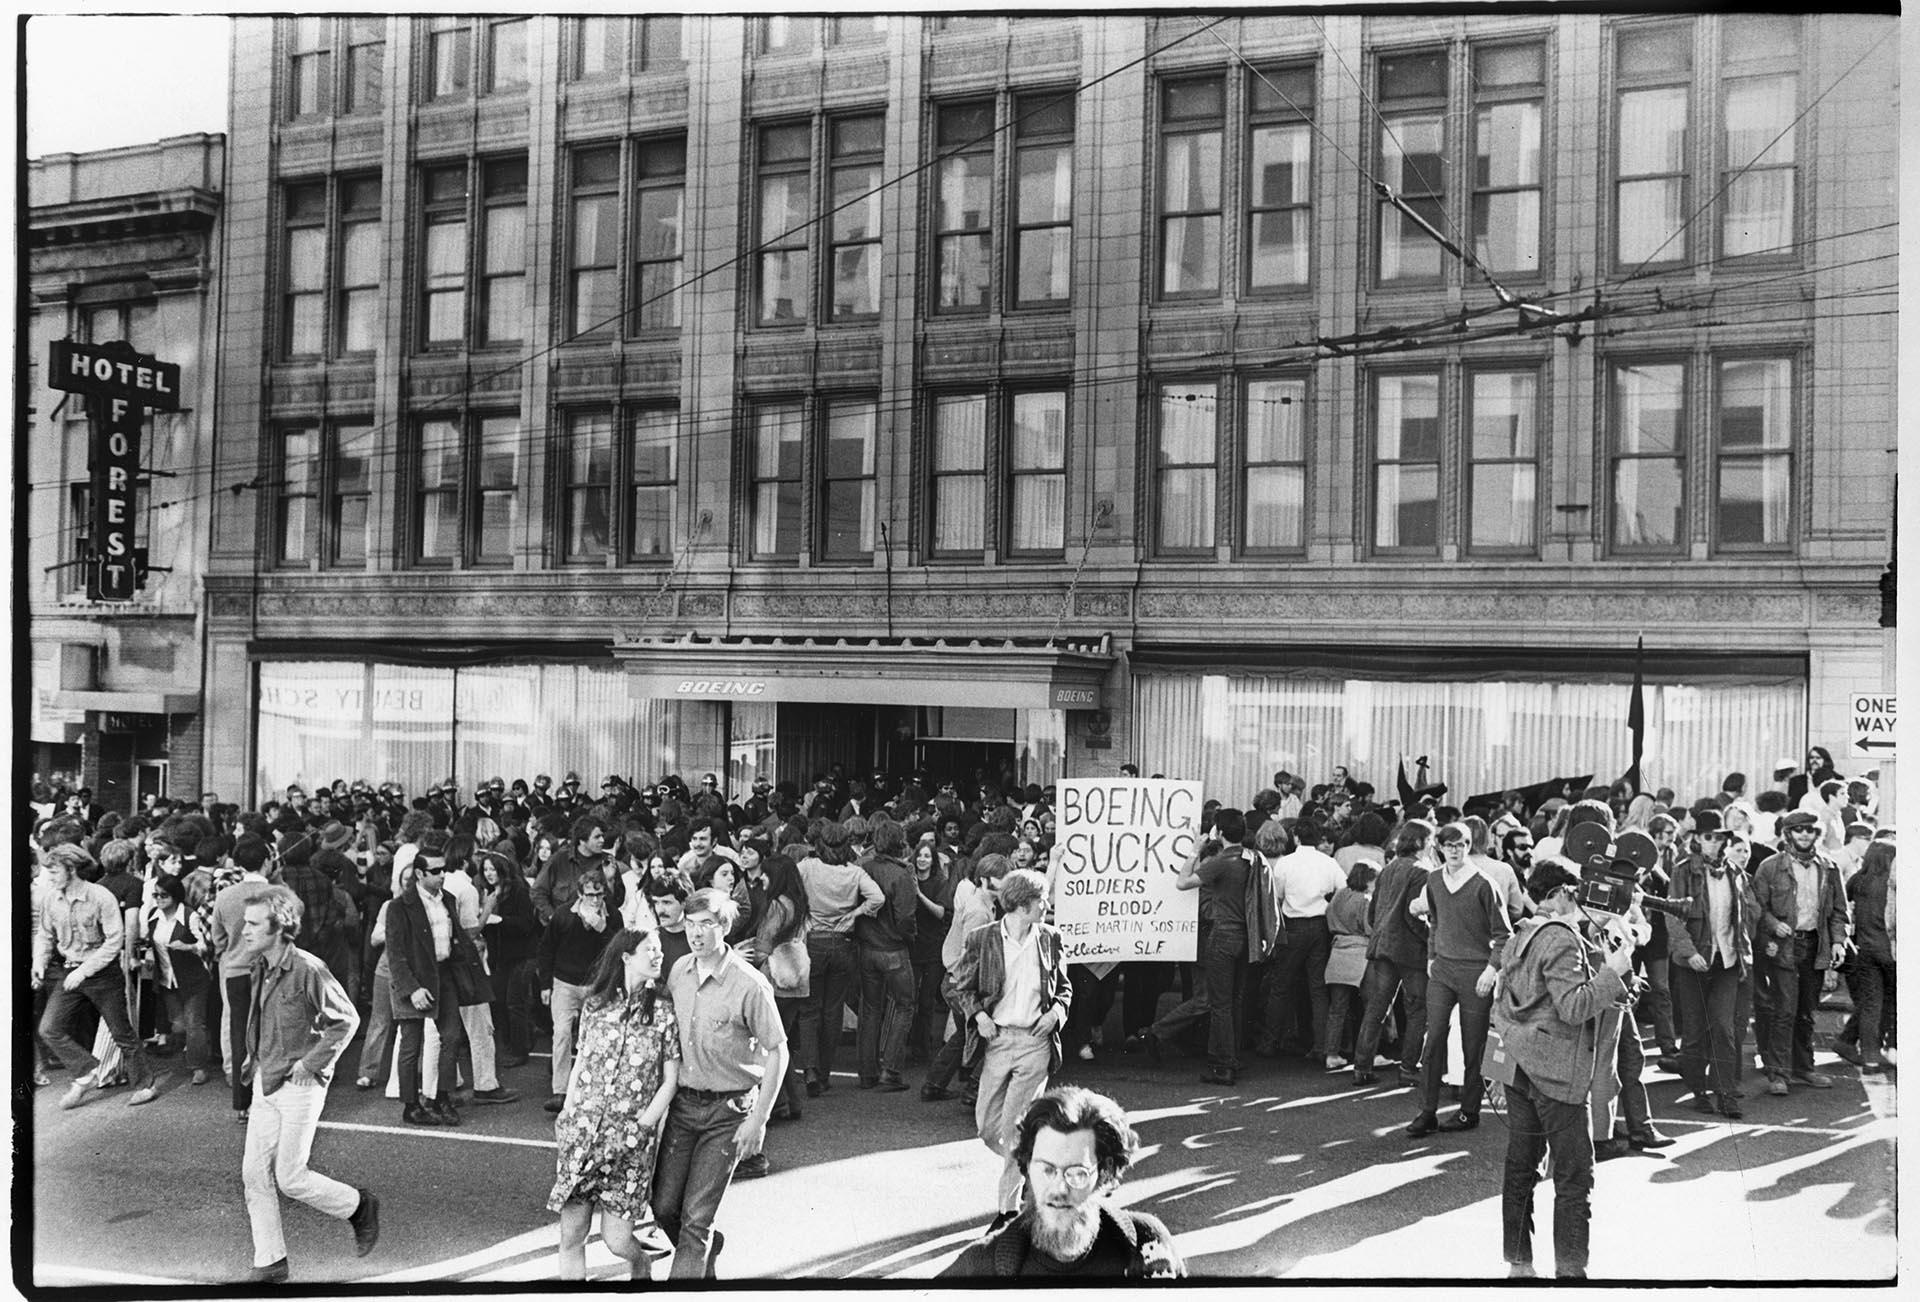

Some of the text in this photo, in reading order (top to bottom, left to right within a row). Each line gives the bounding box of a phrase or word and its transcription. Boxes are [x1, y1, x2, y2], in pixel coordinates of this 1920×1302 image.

[71, 353, 171, 393] HOTEL
[105, 398, 129, 590] FOREST
[676, 681, 765, 695] BOEING
[1056, 690, 1094, 702] BOEING
[1855, 697, 1896, 713] ONE
[1854, 717, 1896, 732] WAY
[1064, 787, 1194, 829] BOEING
[1063, 832, 1195, 875] SUCKS
[1064, 879, 1146, 896] SOLDIERS
[1098, 900, 1163, 916] BLOOD!
[1059, 920, 1197, 936] FREE MARTIN SOSTRE
